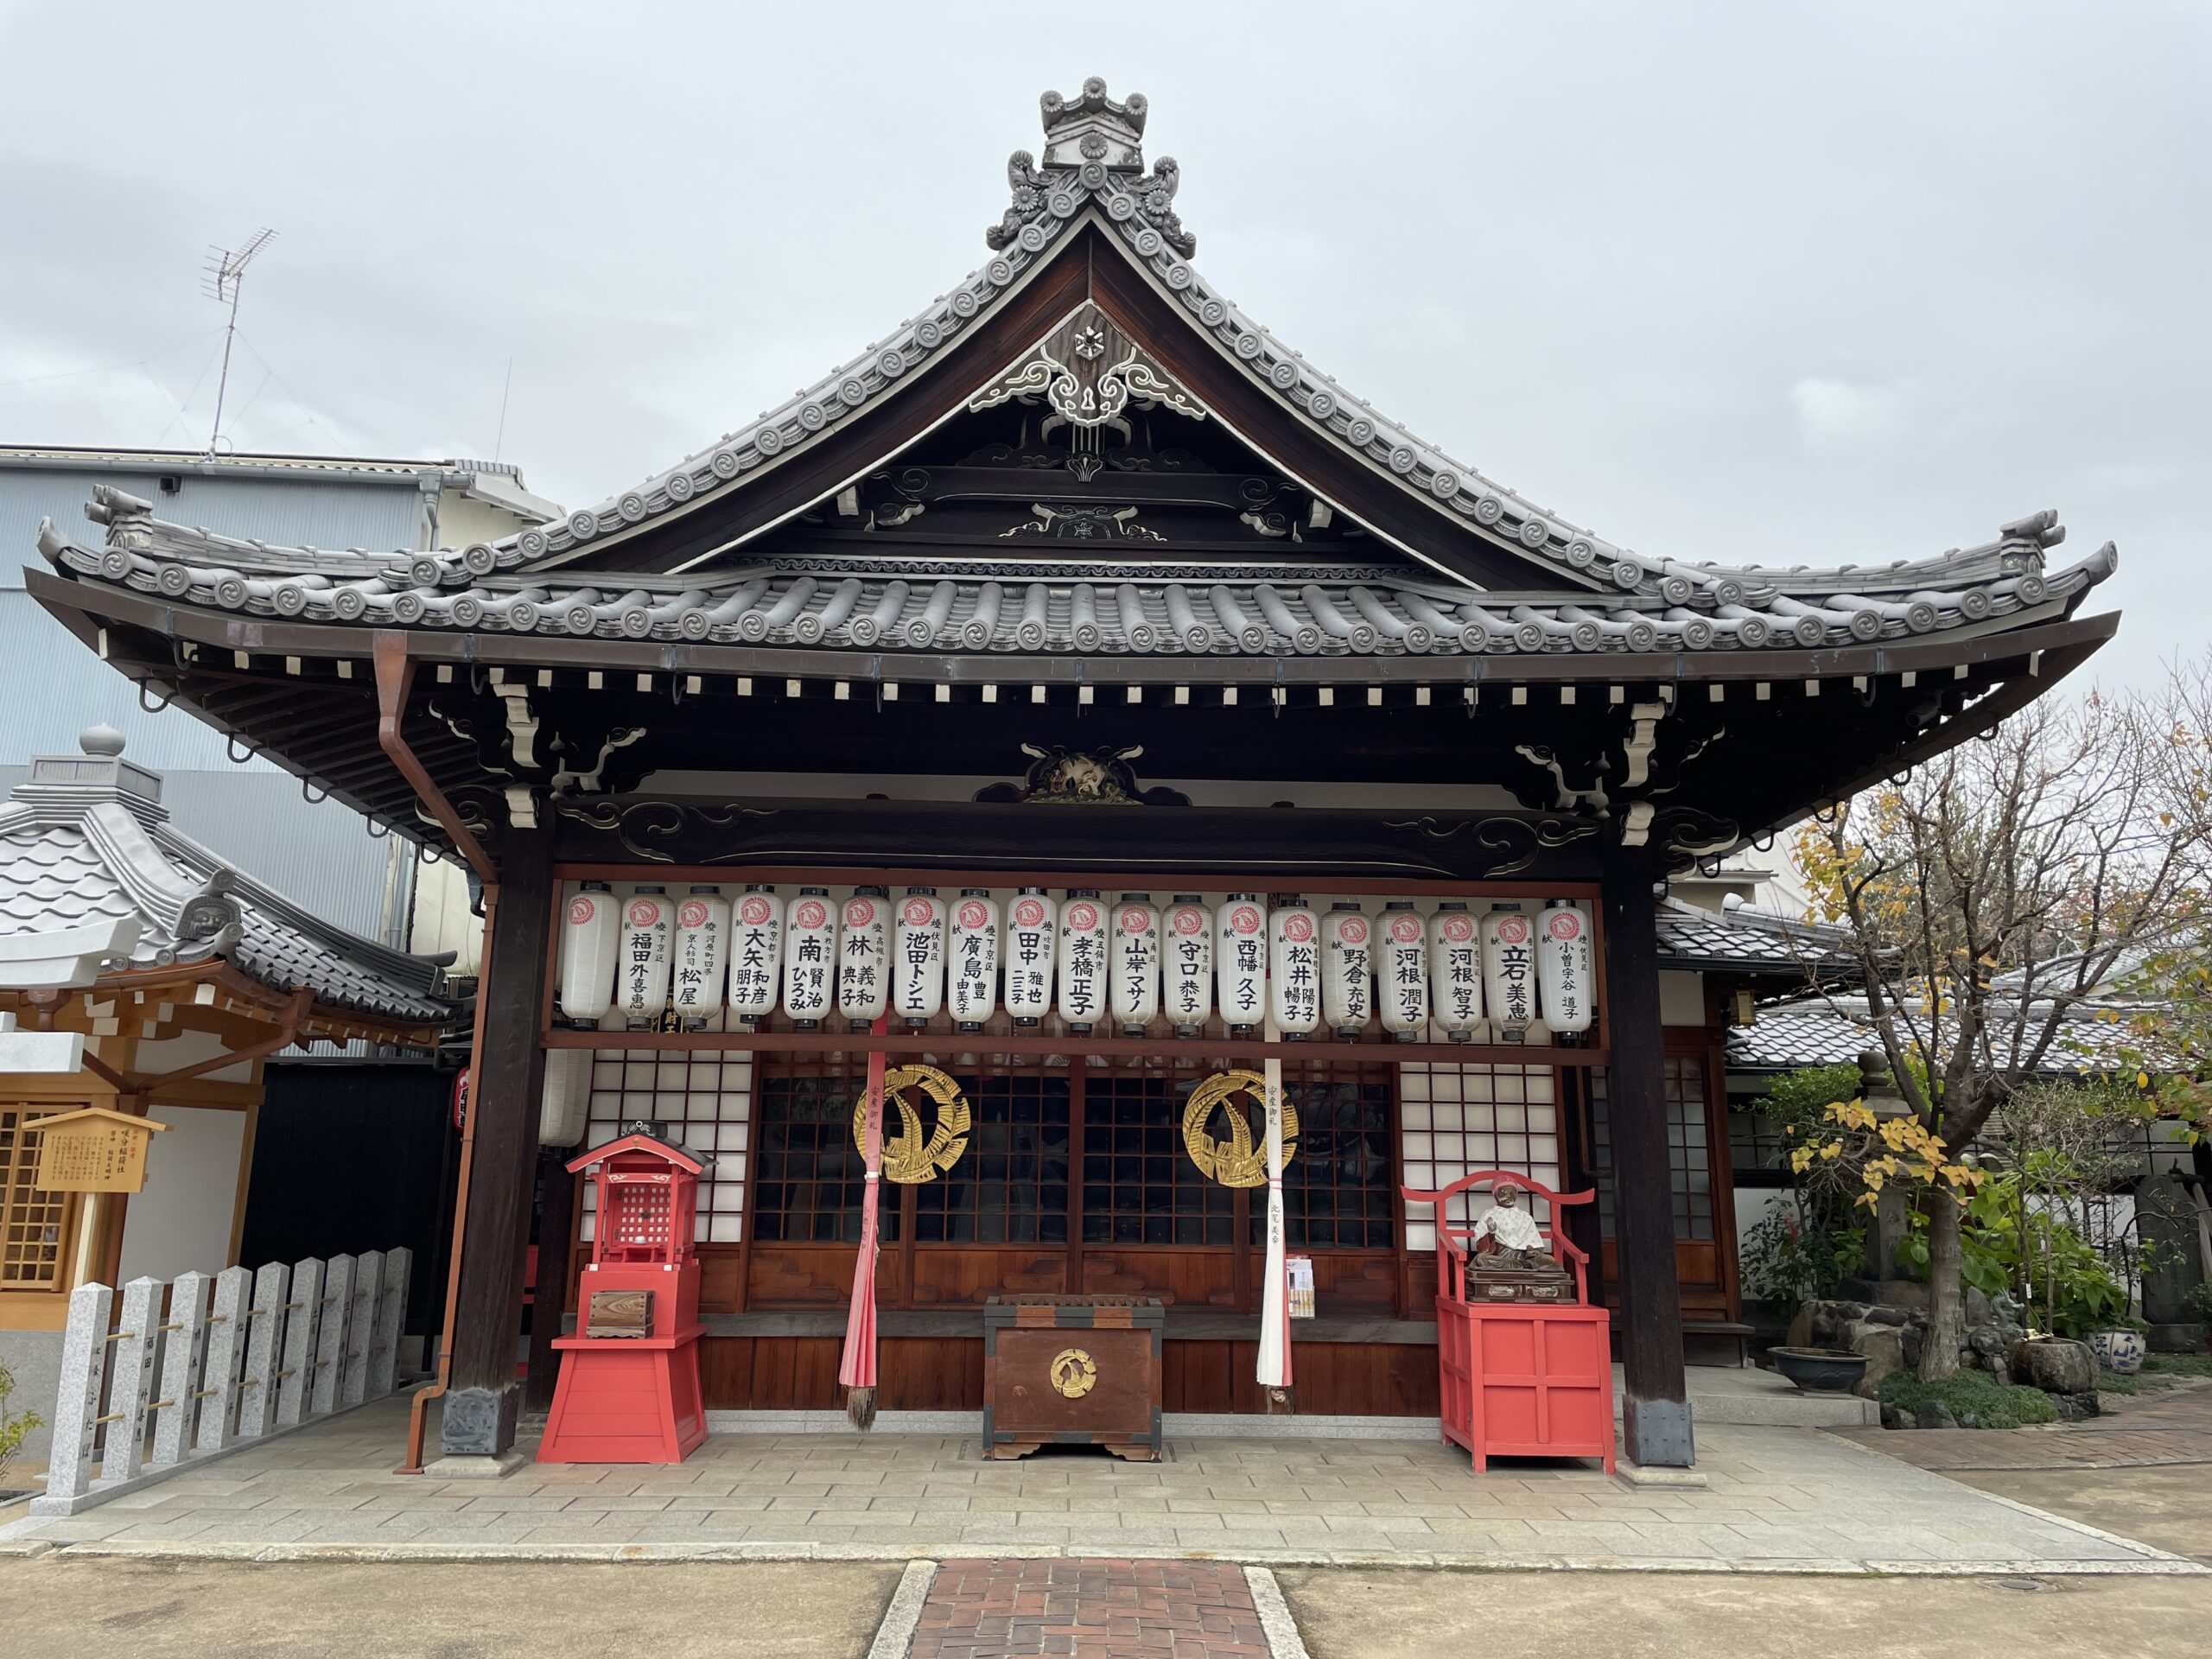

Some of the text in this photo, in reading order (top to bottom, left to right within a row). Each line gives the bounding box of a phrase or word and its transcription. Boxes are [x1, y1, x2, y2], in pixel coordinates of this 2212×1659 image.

[655, 935, 667, 963] 下京区
[684, 933, 698, 966] 京人形司
[743, 928, 766, 968] 大矢
[767, 930, 778, 963] 京都市
[798, 935, 822, 963] 南
[823, 937, 833, 964] 枚方市
[846, 935, 874, 957] 林
[930, 931, 940, 962] 伏見区
[959, 933, 983, 980] 廣島
[984, 938, 995, 971] 下京区
[1018, 931, 1040, 966] 田中
[1201, 944, 1210, 974] 中京区
[906, 931, 930, 1010] 池田トシエ
[1068, 936, 1094, 1016] 孝橋正子
[1179, 940, 1201, 1013] 守口恭子
[1287, 946, 1312, 986] 松井
[677, 968, 702, 1006] 松屋
[735, 969, 752, 1004] 朋子
[750, 969, 769, 1004] 和彦
[790, 967, 807, 1011] ひろみ
[805, 968, 824, 1007] 賢治
[842, 965, 857, 1006] 典子
[855, 965, 876, 1006] 義和
[956, 978, 969, 1014] 由美子
[1011, 969, 1025, 1004] 二三子
[1027, 971, 1044, 1004] 雅也
[1301, 988, 1315, 1022] 陽子
